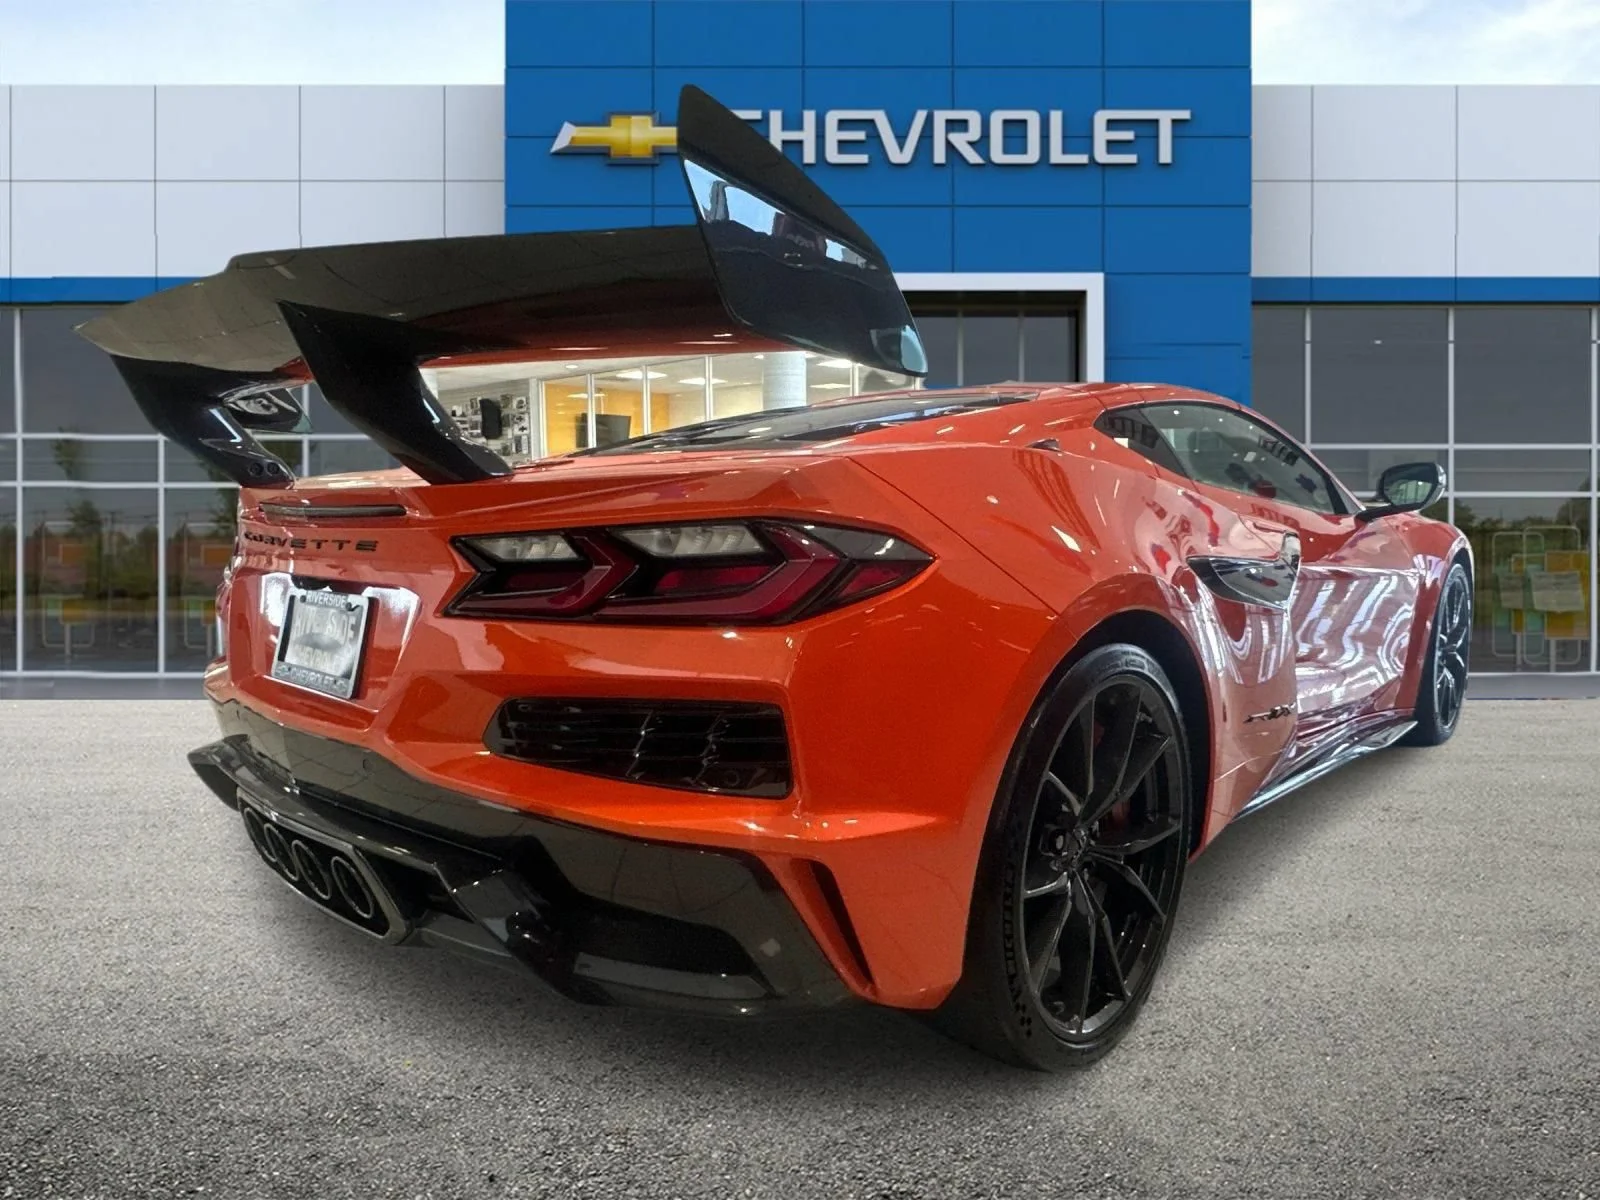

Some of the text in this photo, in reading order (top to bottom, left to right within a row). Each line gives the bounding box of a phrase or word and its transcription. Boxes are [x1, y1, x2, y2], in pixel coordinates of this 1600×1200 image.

[730, 109, 1191, 164] HEVROLET
[244, 531, 379, 551] CORVETTE
[305, 590, 347, 608] RIVERSIDE
